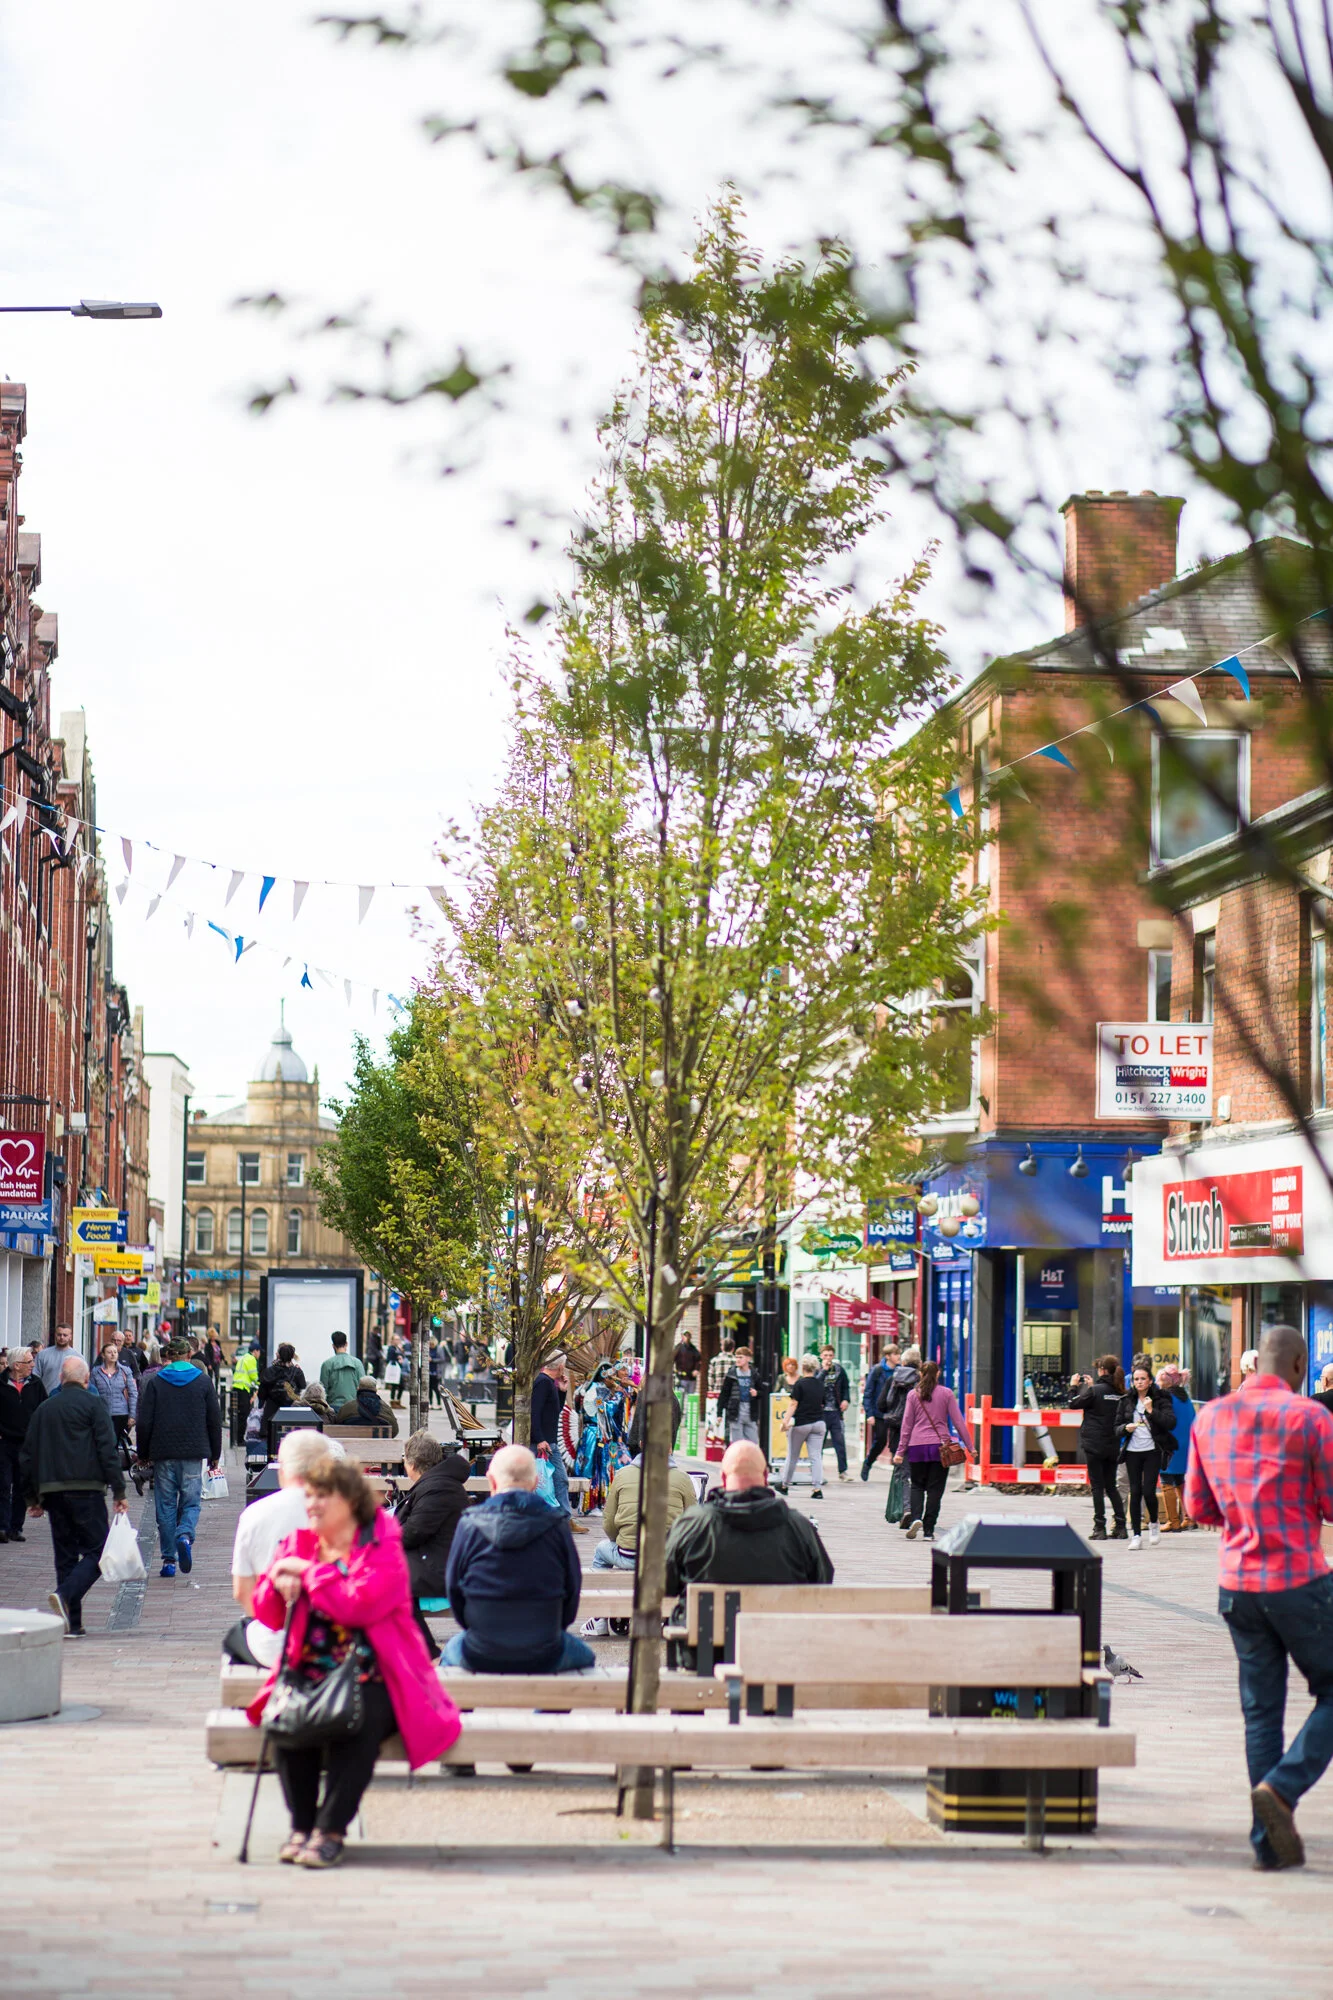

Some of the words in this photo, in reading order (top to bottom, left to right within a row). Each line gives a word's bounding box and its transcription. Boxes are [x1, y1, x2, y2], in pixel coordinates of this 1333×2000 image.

[1114, 1034, 1150, 1055] TO
[1160, 1035, 1208, 1055] LET
[1116, 1066, 1170, 1078] Hitchcock
[1171, 1066, 1207, 1080] Wright
[1150, 1092, 1172, 1104] 227
[1176, 1093, 1206, 1105] 3400
[15, 1182, 37, 1190] Heart
[1272, 1175, 1297, 1194] LONDON
[1272, 1194, 1290, 1212] PARIS
[1, 1210, 48, 1221] HALIFAX
[1167, 1186, 1224, 1257] Shush
[1272, 1214, 1286, 1230] NEW
[1285, 1213, 1302, 1229] YORK
[86, 1223, 112, 1231] Heron
[86, 1232, 111, 1240] Foods
[1041, 1269, 1065, 1282] H&T
